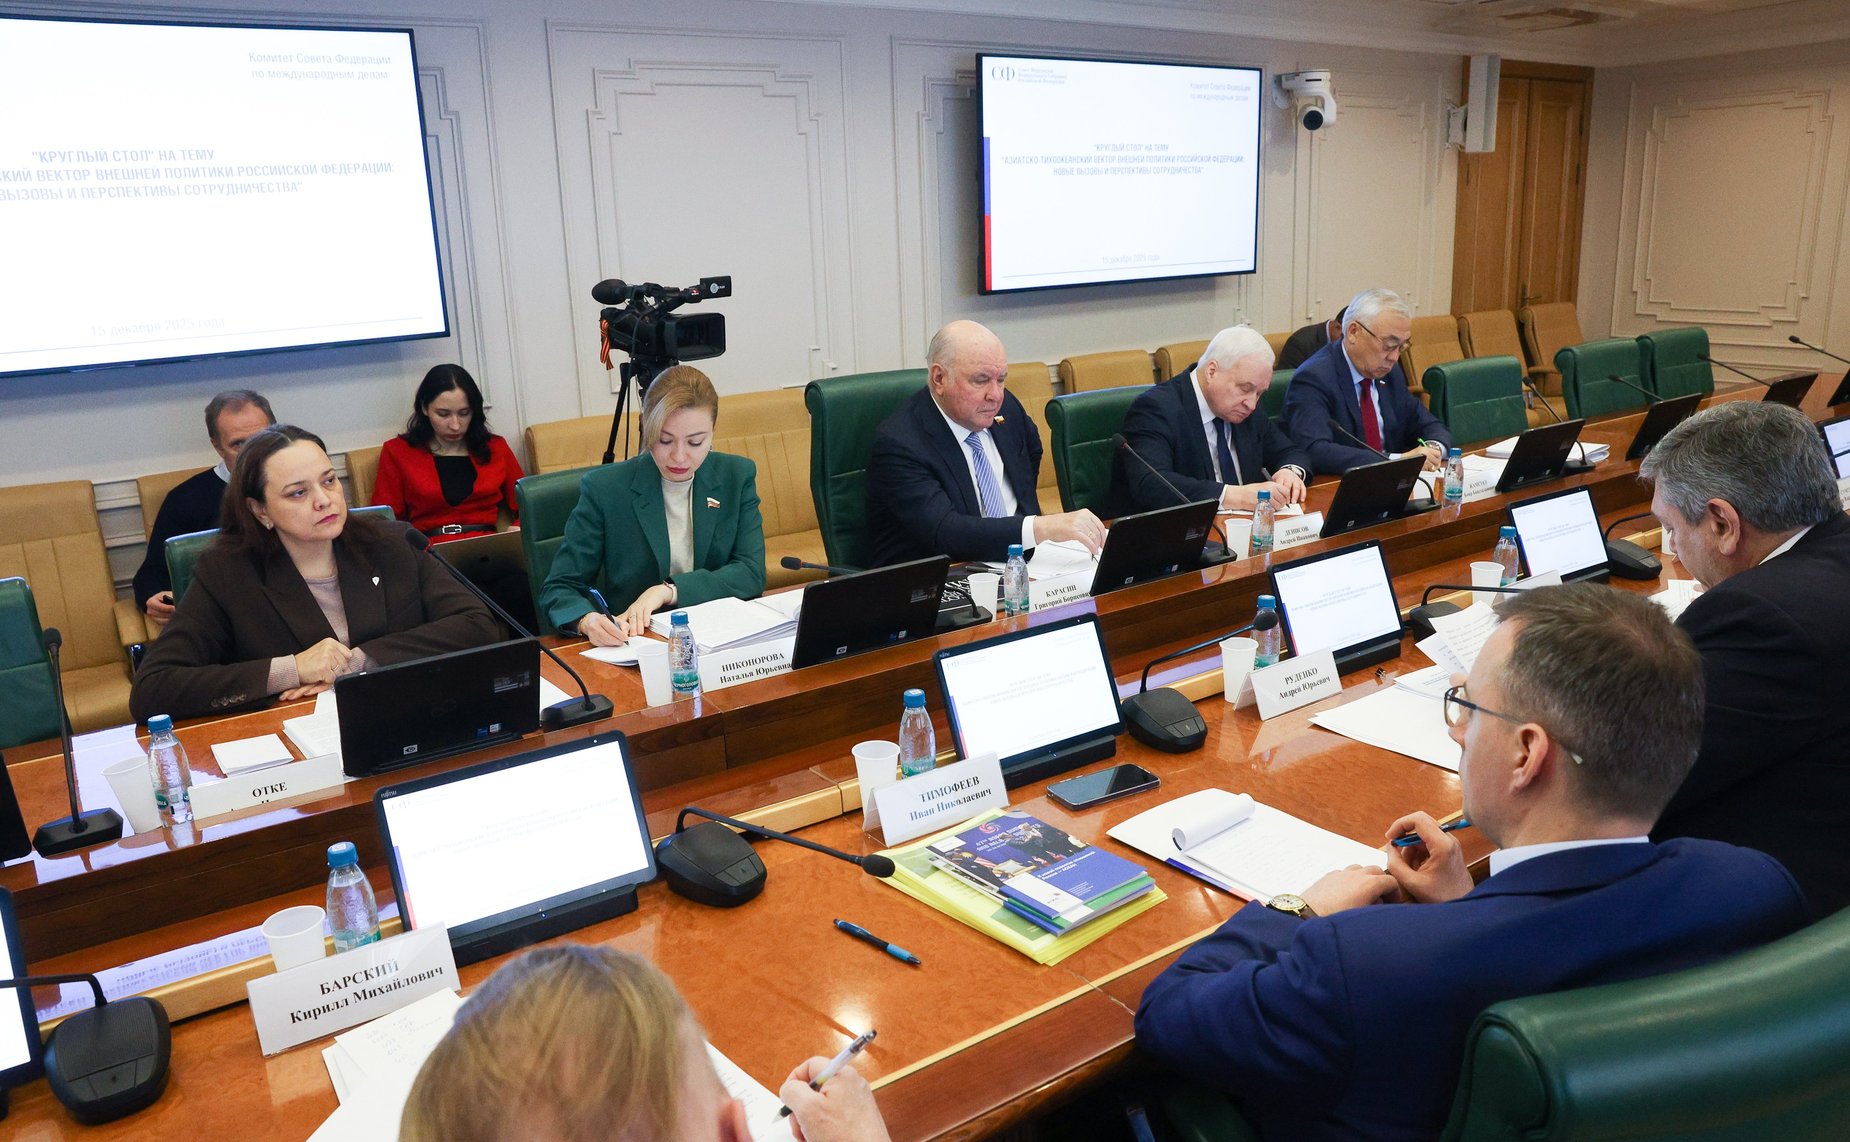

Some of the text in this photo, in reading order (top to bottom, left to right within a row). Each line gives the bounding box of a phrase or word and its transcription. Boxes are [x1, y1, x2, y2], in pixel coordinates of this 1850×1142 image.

[248, 51, 392, 66] Комитет Совета Федерации
[251, 70, 265, 79] по
[357, 70, 389, 80] делам
[32, 148, 214, 164] "КРУГЛЫЙ СТОЛ" НА ТЕМУ
[0, 168, 32, 183] КИЙ
[36, 169, 90, 182] ВЕКТОР
[96, 166, 161, 181] ВНЕШНЕЙ
[165, 166, 234, 179] ПОЛИТИКИ
[237, 162, 318, 177] РОССИЙСКОЙ
[68, 187, 77, 199] И
[81, 185, 180, 199] ПЕРСПЕКТИВЫ
[184, 181, 303, 197] СОТРУДНИЧЕСТВА"
[1045, 584, 1077, 598] КАРАСИН
[1034, 597, 1063, 610] Григорий
[721, 652, 785, 672] НИКОНОРОВА
[719, 663, 792, 684] Наталья Юрьевна
[1284, 667, 1318, 685] РУДЕНКО
[1279, 676, 1331, 700] Андрей Юрьевич
[252, 782, 288, 798] ОТКЕ
[919, 775, 980, 803] ТИМОФЕЕВ
[909, 788, 992, 821] Иван Николаевич
[318, 957, 400, 996] БАРСКИЙ
[290, 966, 444, 1025] Кирилл Михайлович
